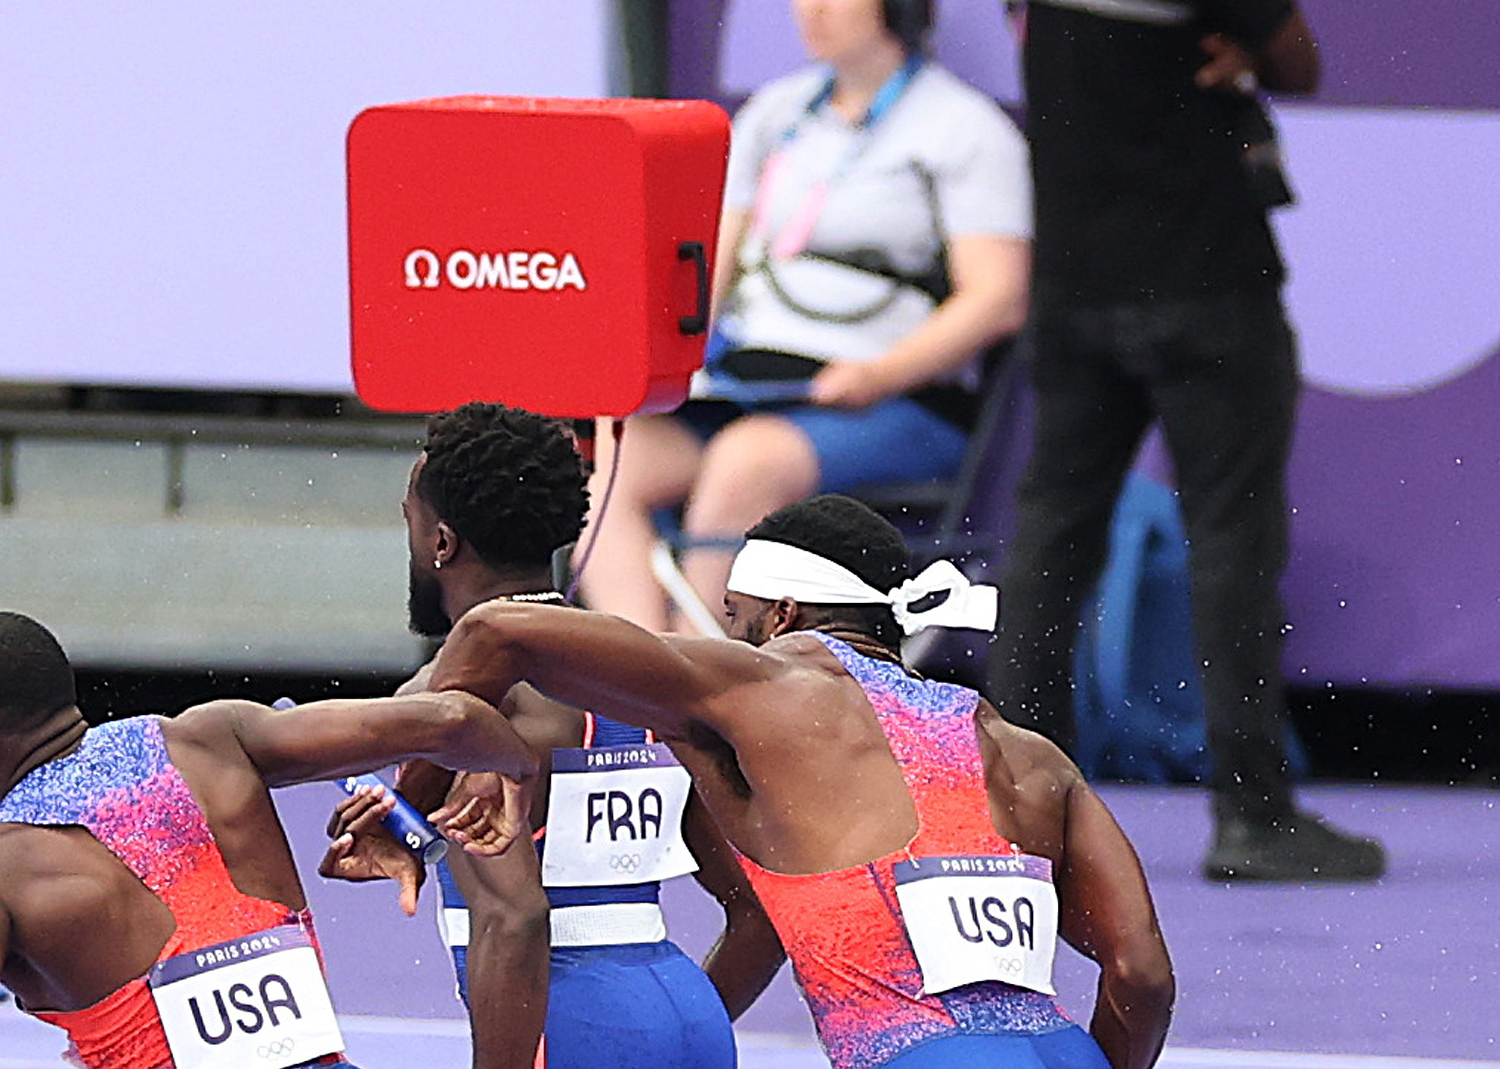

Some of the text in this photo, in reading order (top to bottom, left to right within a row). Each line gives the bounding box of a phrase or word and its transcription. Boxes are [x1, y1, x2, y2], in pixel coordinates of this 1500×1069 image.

[446, 249, 586, 290] OMEGA
[588, 752, 622, 766] PARIS
[586, 787, 662, 843] FRA
[941, 859, 1026, 872] PARIS 2024
[948, 896, 1034, 951] USA
[196, 936, 281, 968] PARIS 2024
[188, 974, 302, 1045] USA
